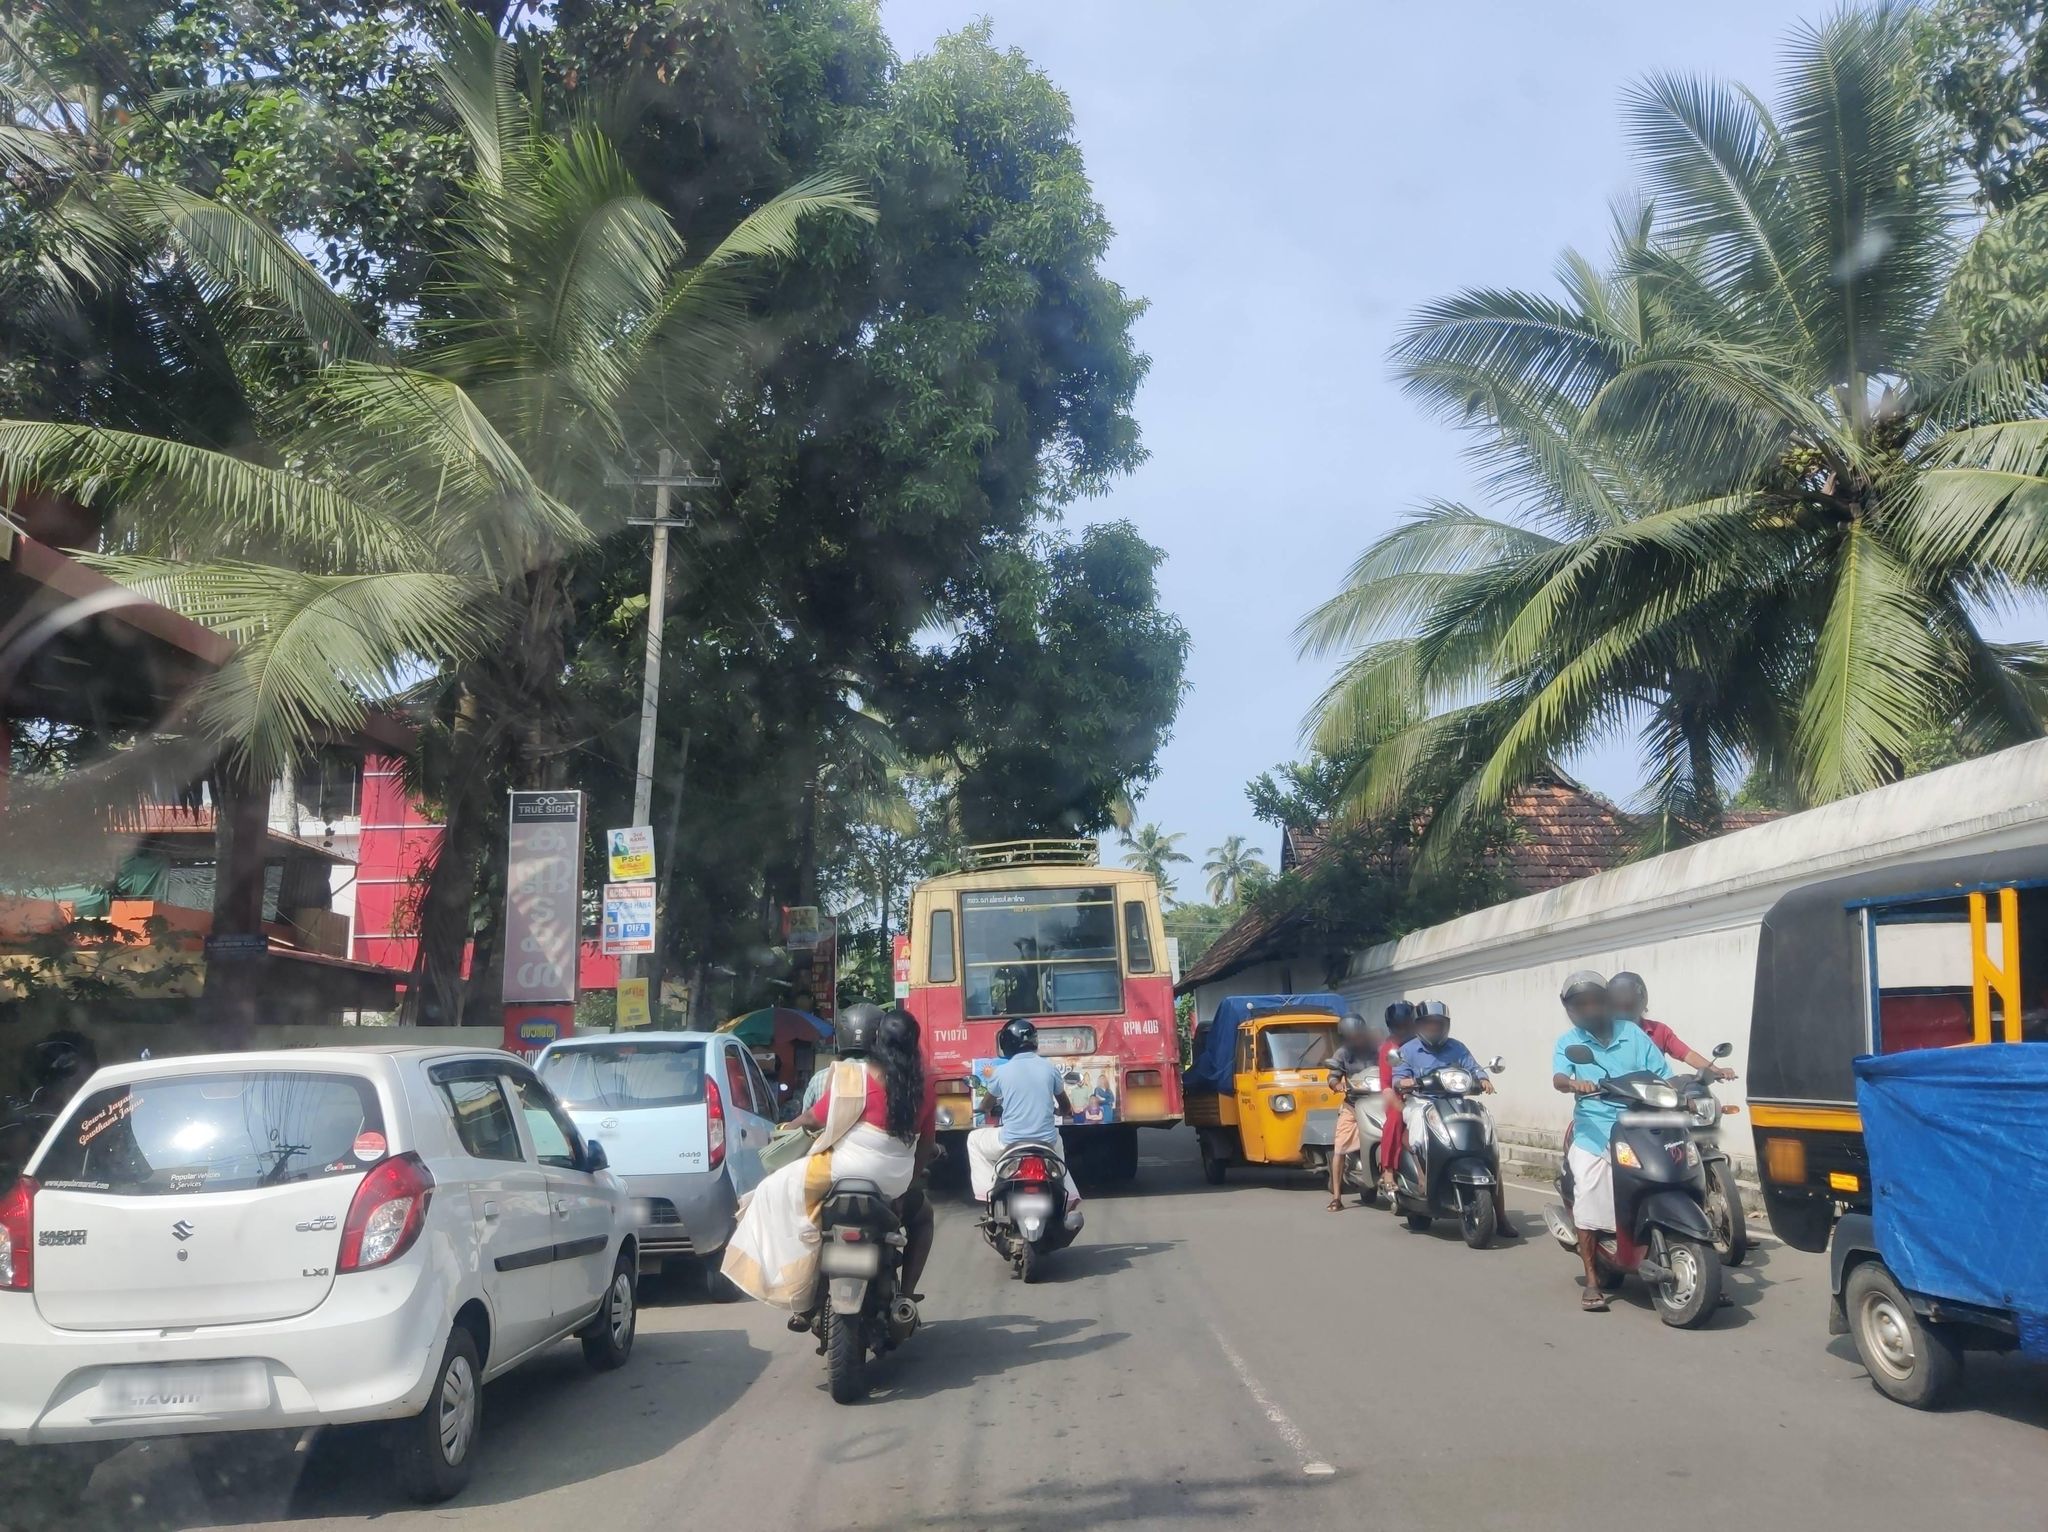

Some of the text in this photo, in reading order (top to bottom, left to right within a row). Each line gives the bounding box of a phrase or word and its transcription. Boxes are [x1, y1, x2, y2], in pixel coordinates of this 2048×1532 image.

[519, 804, 575, 814] TRUE SIGHT
[621, 855, 642, 863] PSC
[933, 1029, 968, 1042] TV1070
[108, 1093, 134, 1115] Jagan
[170, 1171, 221, 1182] Popular Vehicles
[177, 1180, 202, 1190] Services
[295, 1221, 338, 1232] 800
[38, 1236, 87, 1247] SUZUKI
